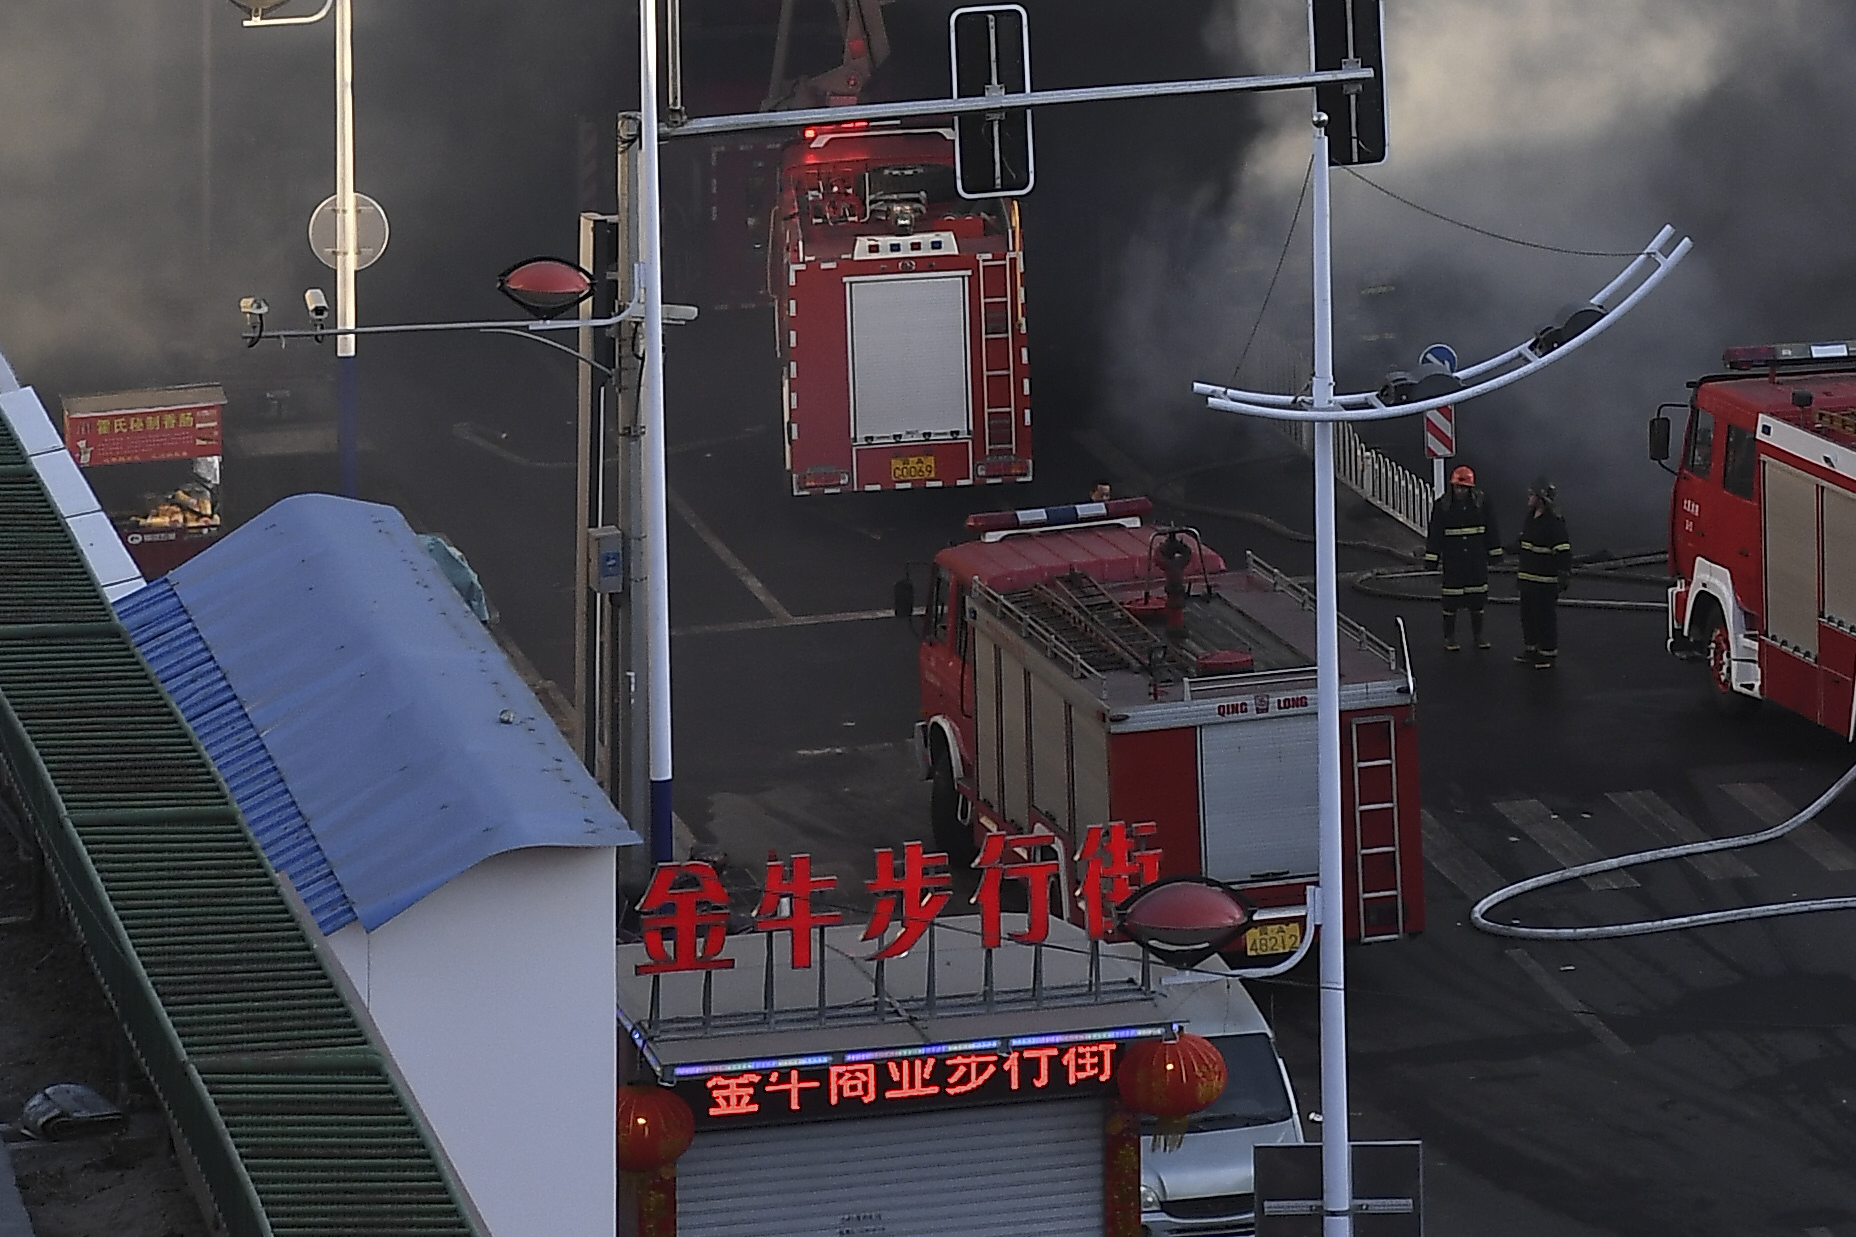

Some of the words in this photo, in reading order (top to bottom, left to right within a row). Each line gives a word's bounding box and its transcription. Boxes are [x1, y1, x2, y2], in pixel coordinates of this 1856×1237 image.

[1217, 702, 1248, 717] QING
[1277, 696, 1308, 710] LONG
[634, 820, 1161, 976] 金牛步行街
